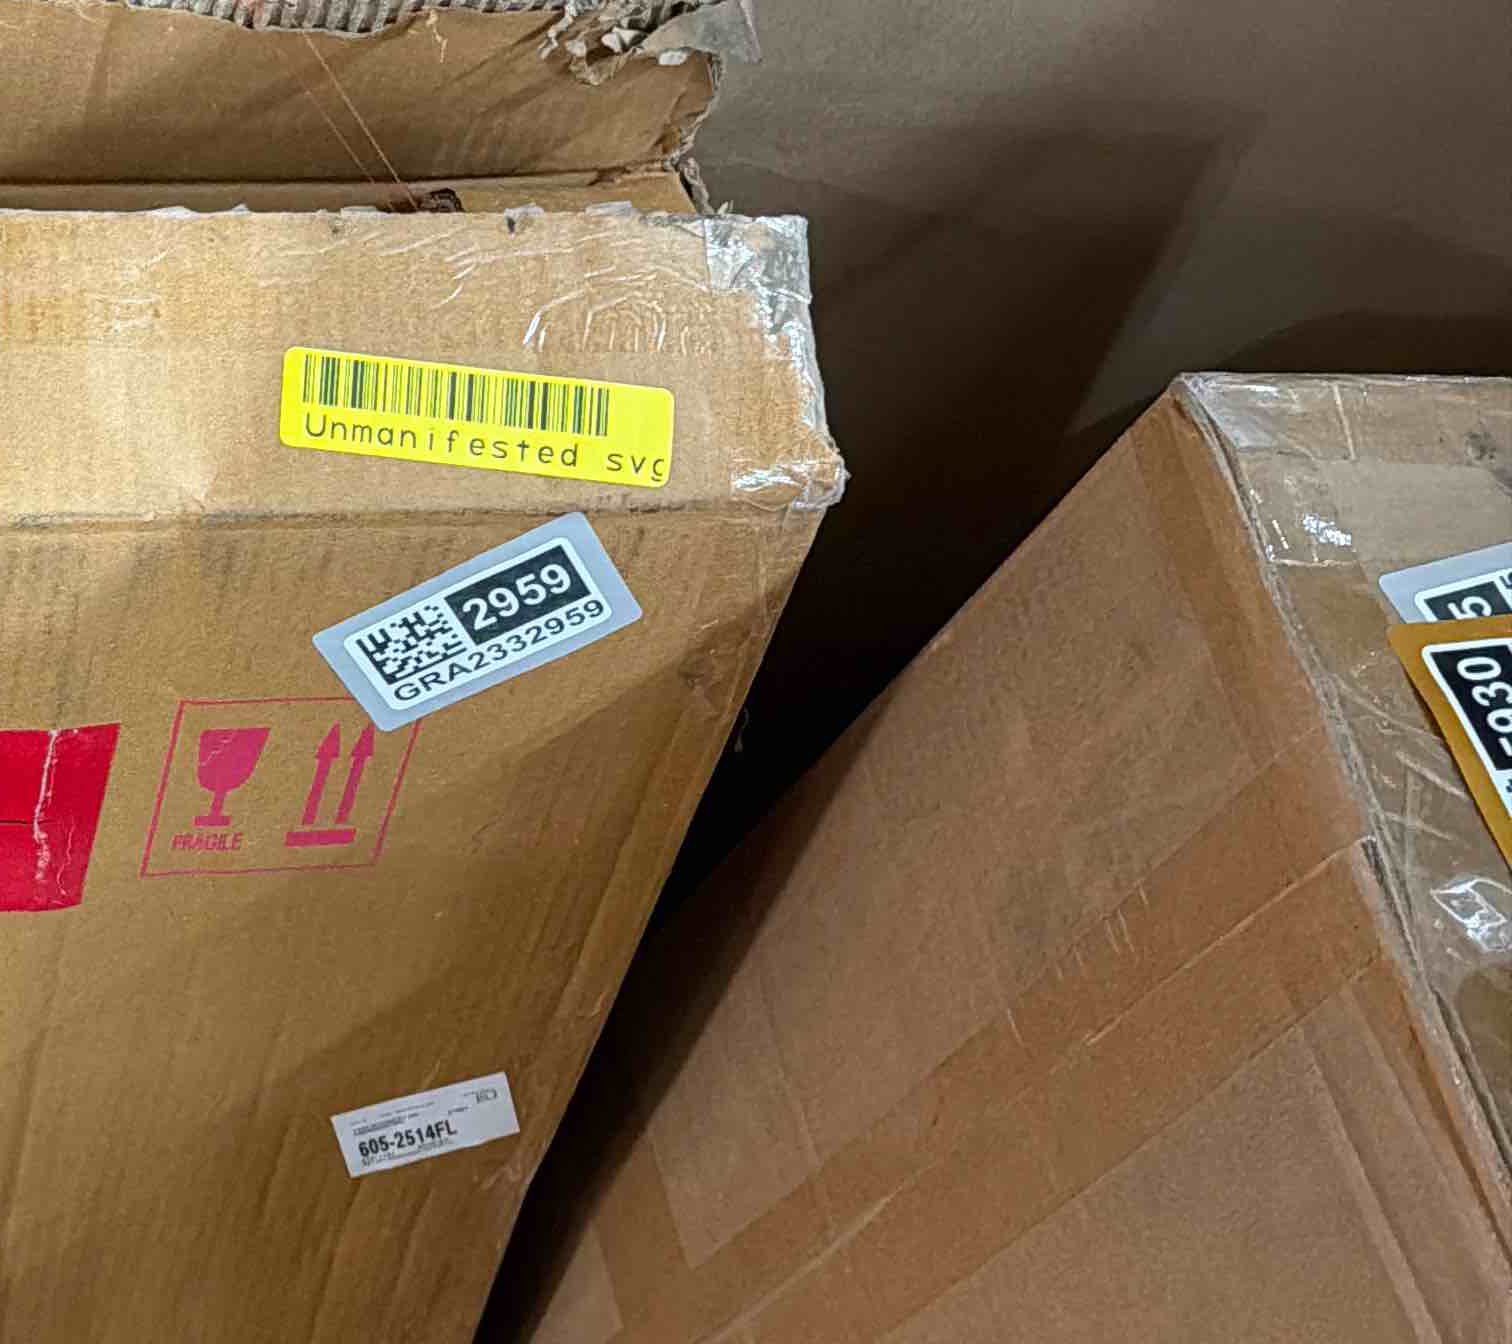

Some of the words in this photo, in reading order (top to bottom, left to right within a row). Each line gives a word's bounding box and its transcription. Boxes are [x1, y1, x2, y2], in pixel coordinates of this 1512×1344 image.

[304, 413, 579, 468] Unmanifested
[461, 563, 572, 632] 2959
[394, 599, 604, 703] GRA2332959
[358, 1119, 457, 1157] 605-2514FL
